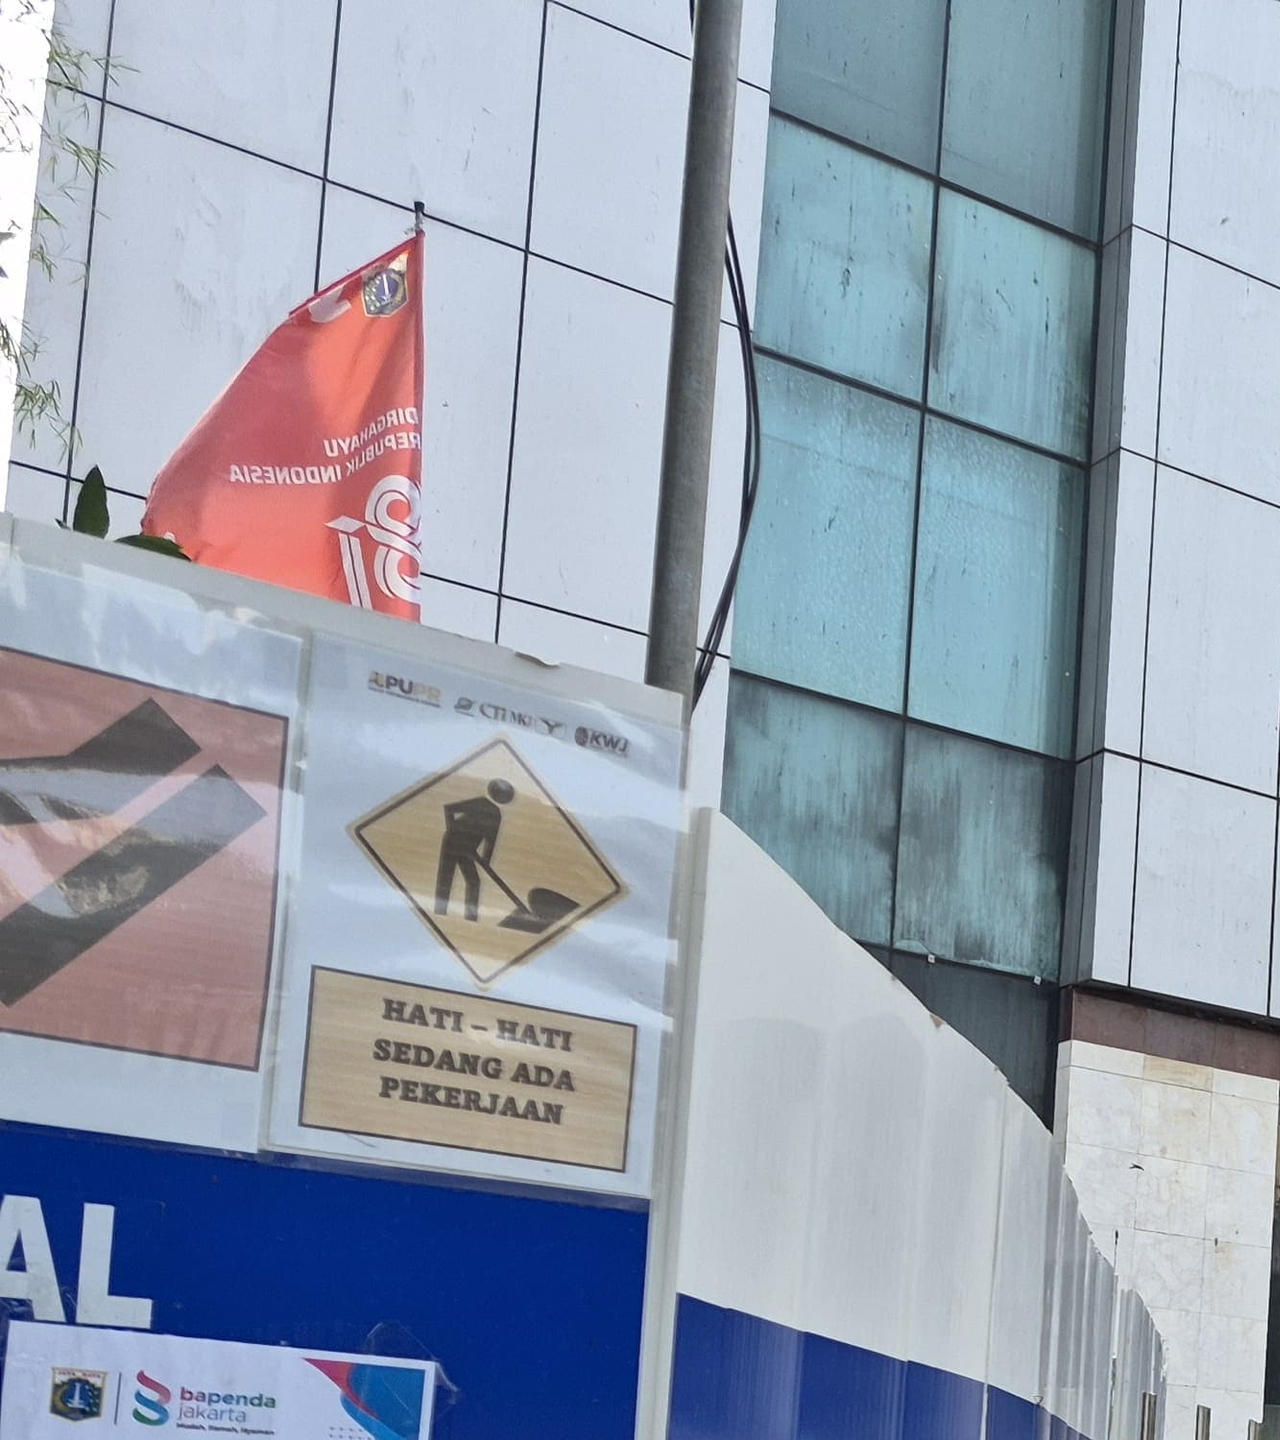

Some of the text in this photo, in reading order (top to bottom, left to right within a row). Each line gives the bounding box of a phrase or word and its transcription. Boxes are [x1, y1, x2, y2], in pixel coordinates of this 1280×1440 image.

[382, 998, 463, 1033] HATI
[495, 1019, 573, 1052] HATI
[373, 1038, 576, 1092] SEDANG ADA
[378, 1076, 564, 1126] PEKERJAAN
[177, 1402, 247, 1423] jakarta
[180, 1387, 276, 1408] bapenda
